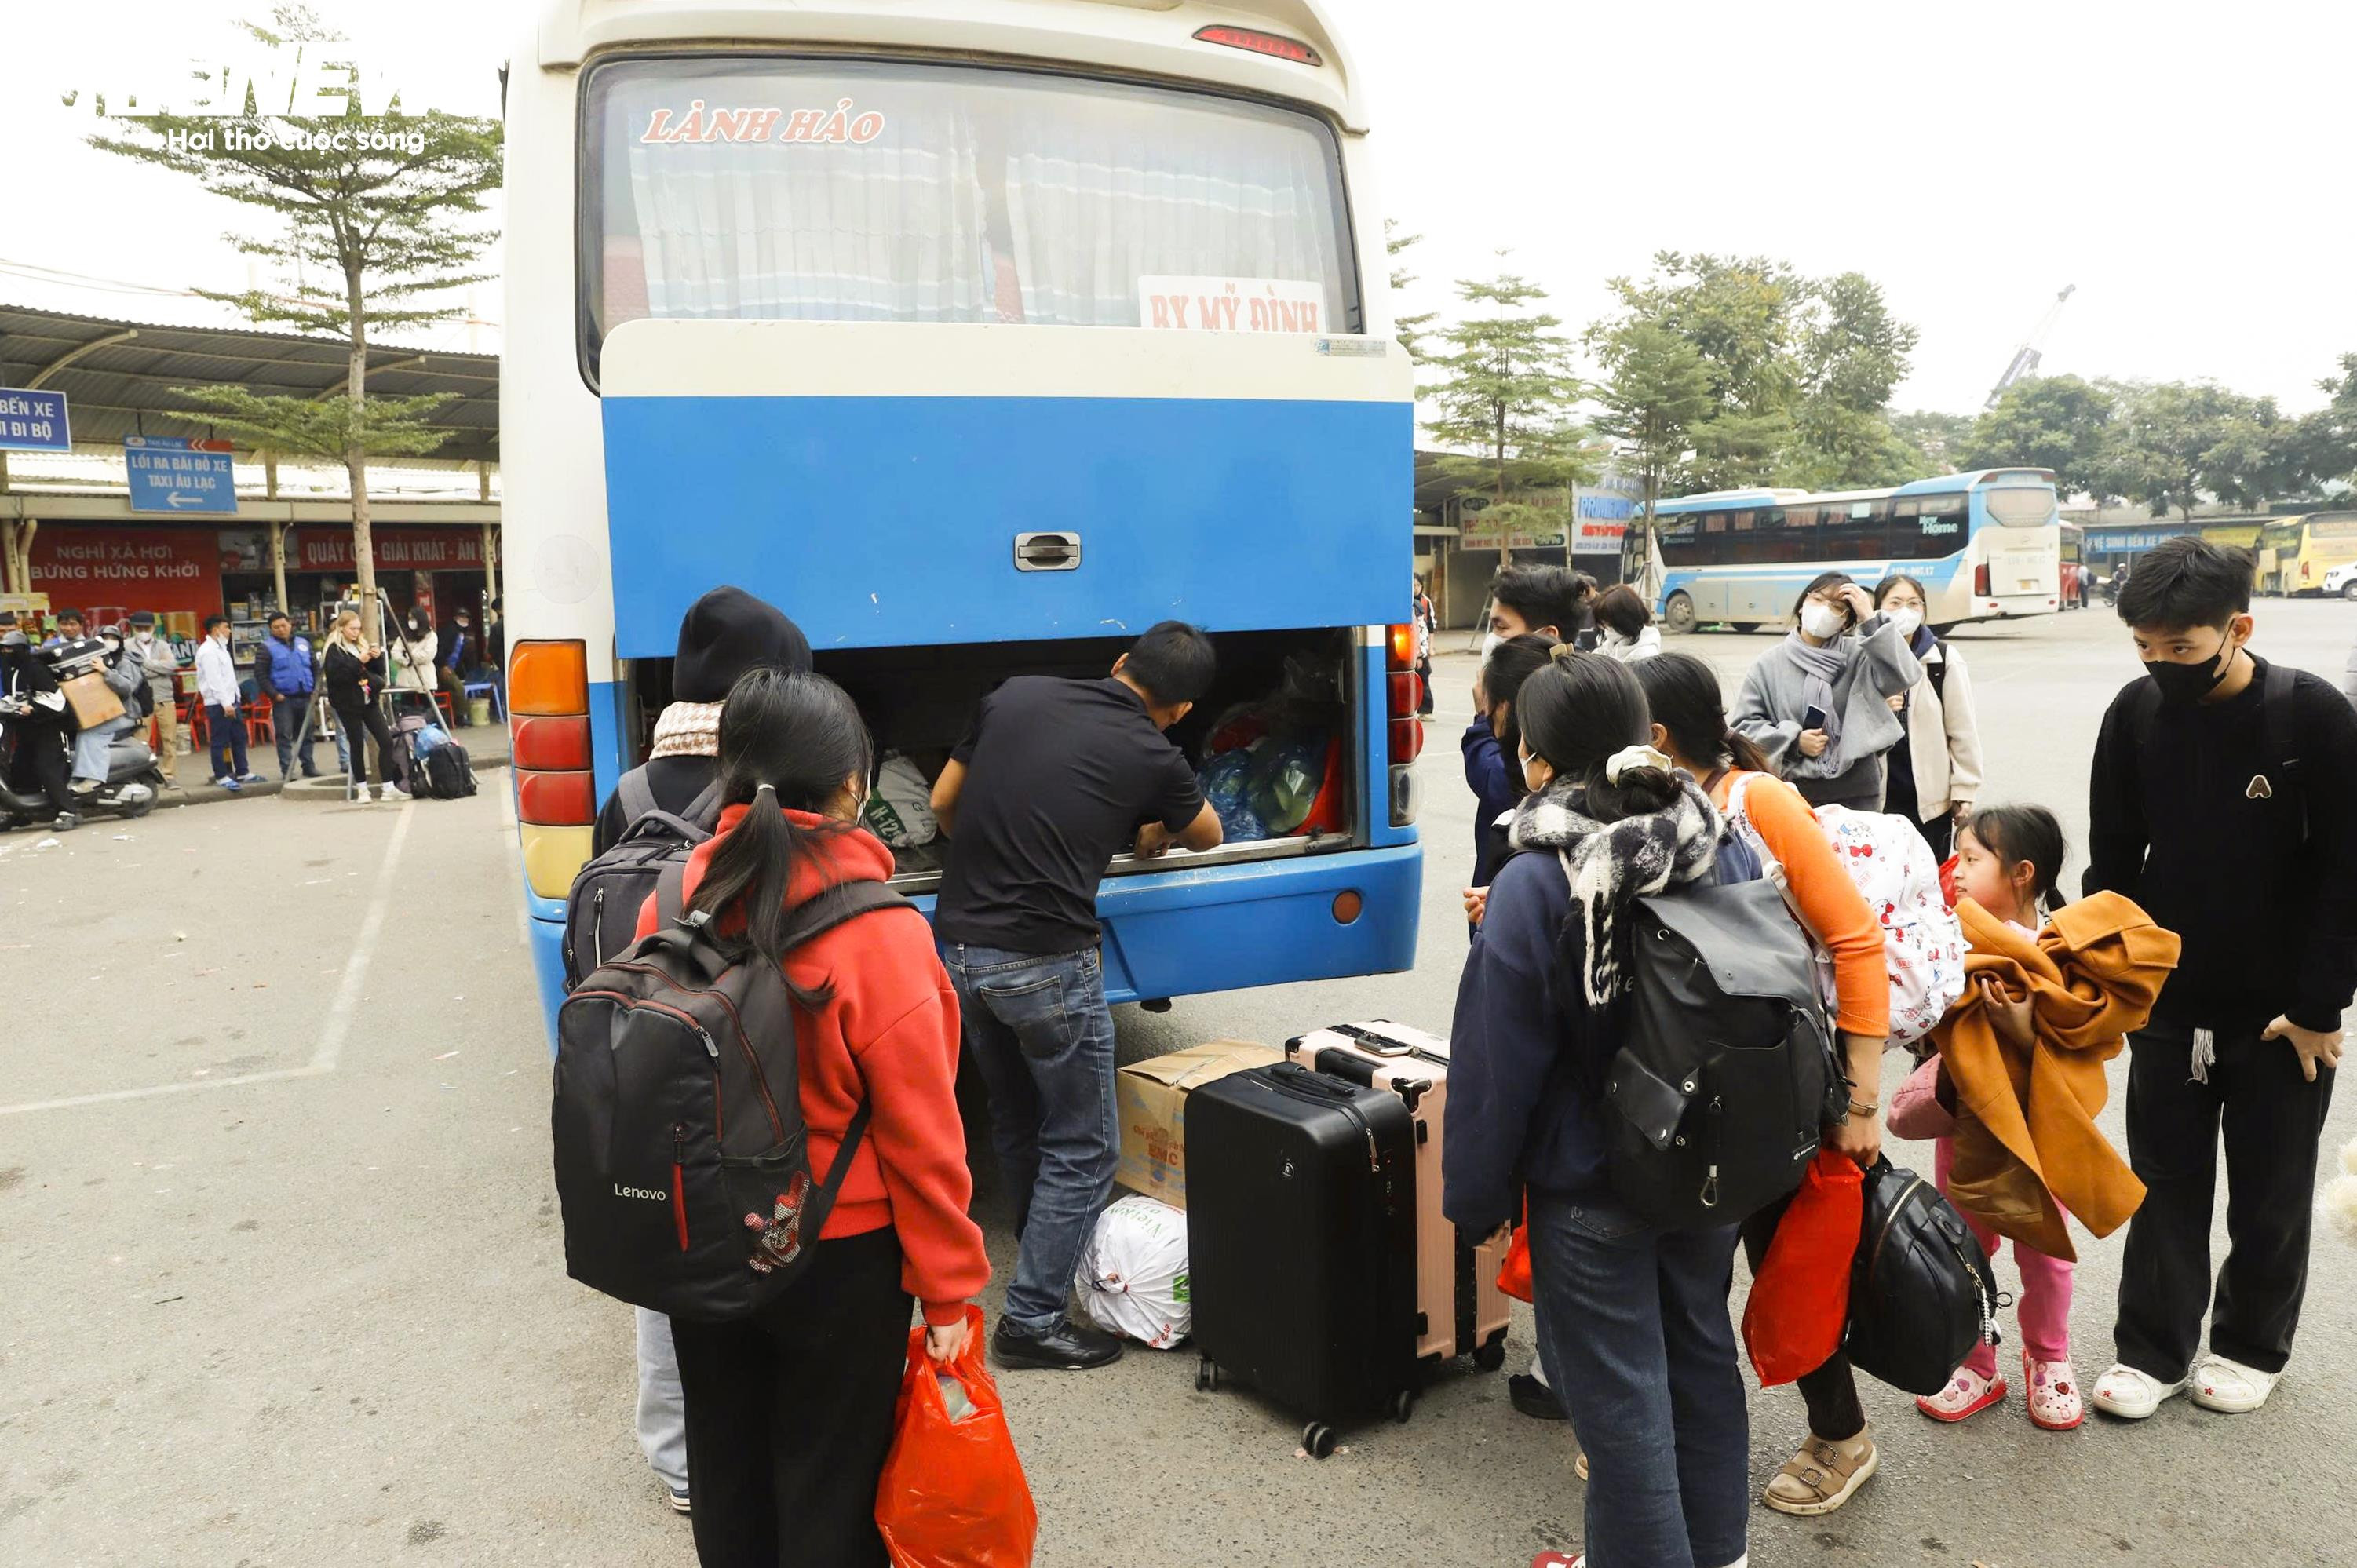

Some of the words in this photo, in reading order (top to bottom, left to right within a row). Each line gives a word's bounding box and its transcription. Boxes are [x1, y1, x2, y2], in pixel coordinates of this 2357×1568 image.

[779, 97, 885, 144] HẢO
[1198, 282, 1241, 331] MỸ
[1248, 284, 1318, 334] ĐÌNH
[0, 396, 30, 416] BẾN
[33, 401, 55, 418] XE
[11, 421, 27, 437] ĐI
[31, 420, 53, 441] BỘ
[130, 452, 150, 469] LỐI
[153, 457, 170, 470] RA
[213, 459, 228, 472] XE
[148, 474, 173, 488] TAXI
[176, 472, 192, 489] ÂU
[194, 476, 217, 492] LẠC
[1922, 523, 1959, 534] Home
[141, 545, 172, 560] HƠI
[155, 560, 199, 578] KHỞI
[615, 1183, 666, 1201] Lenovo
